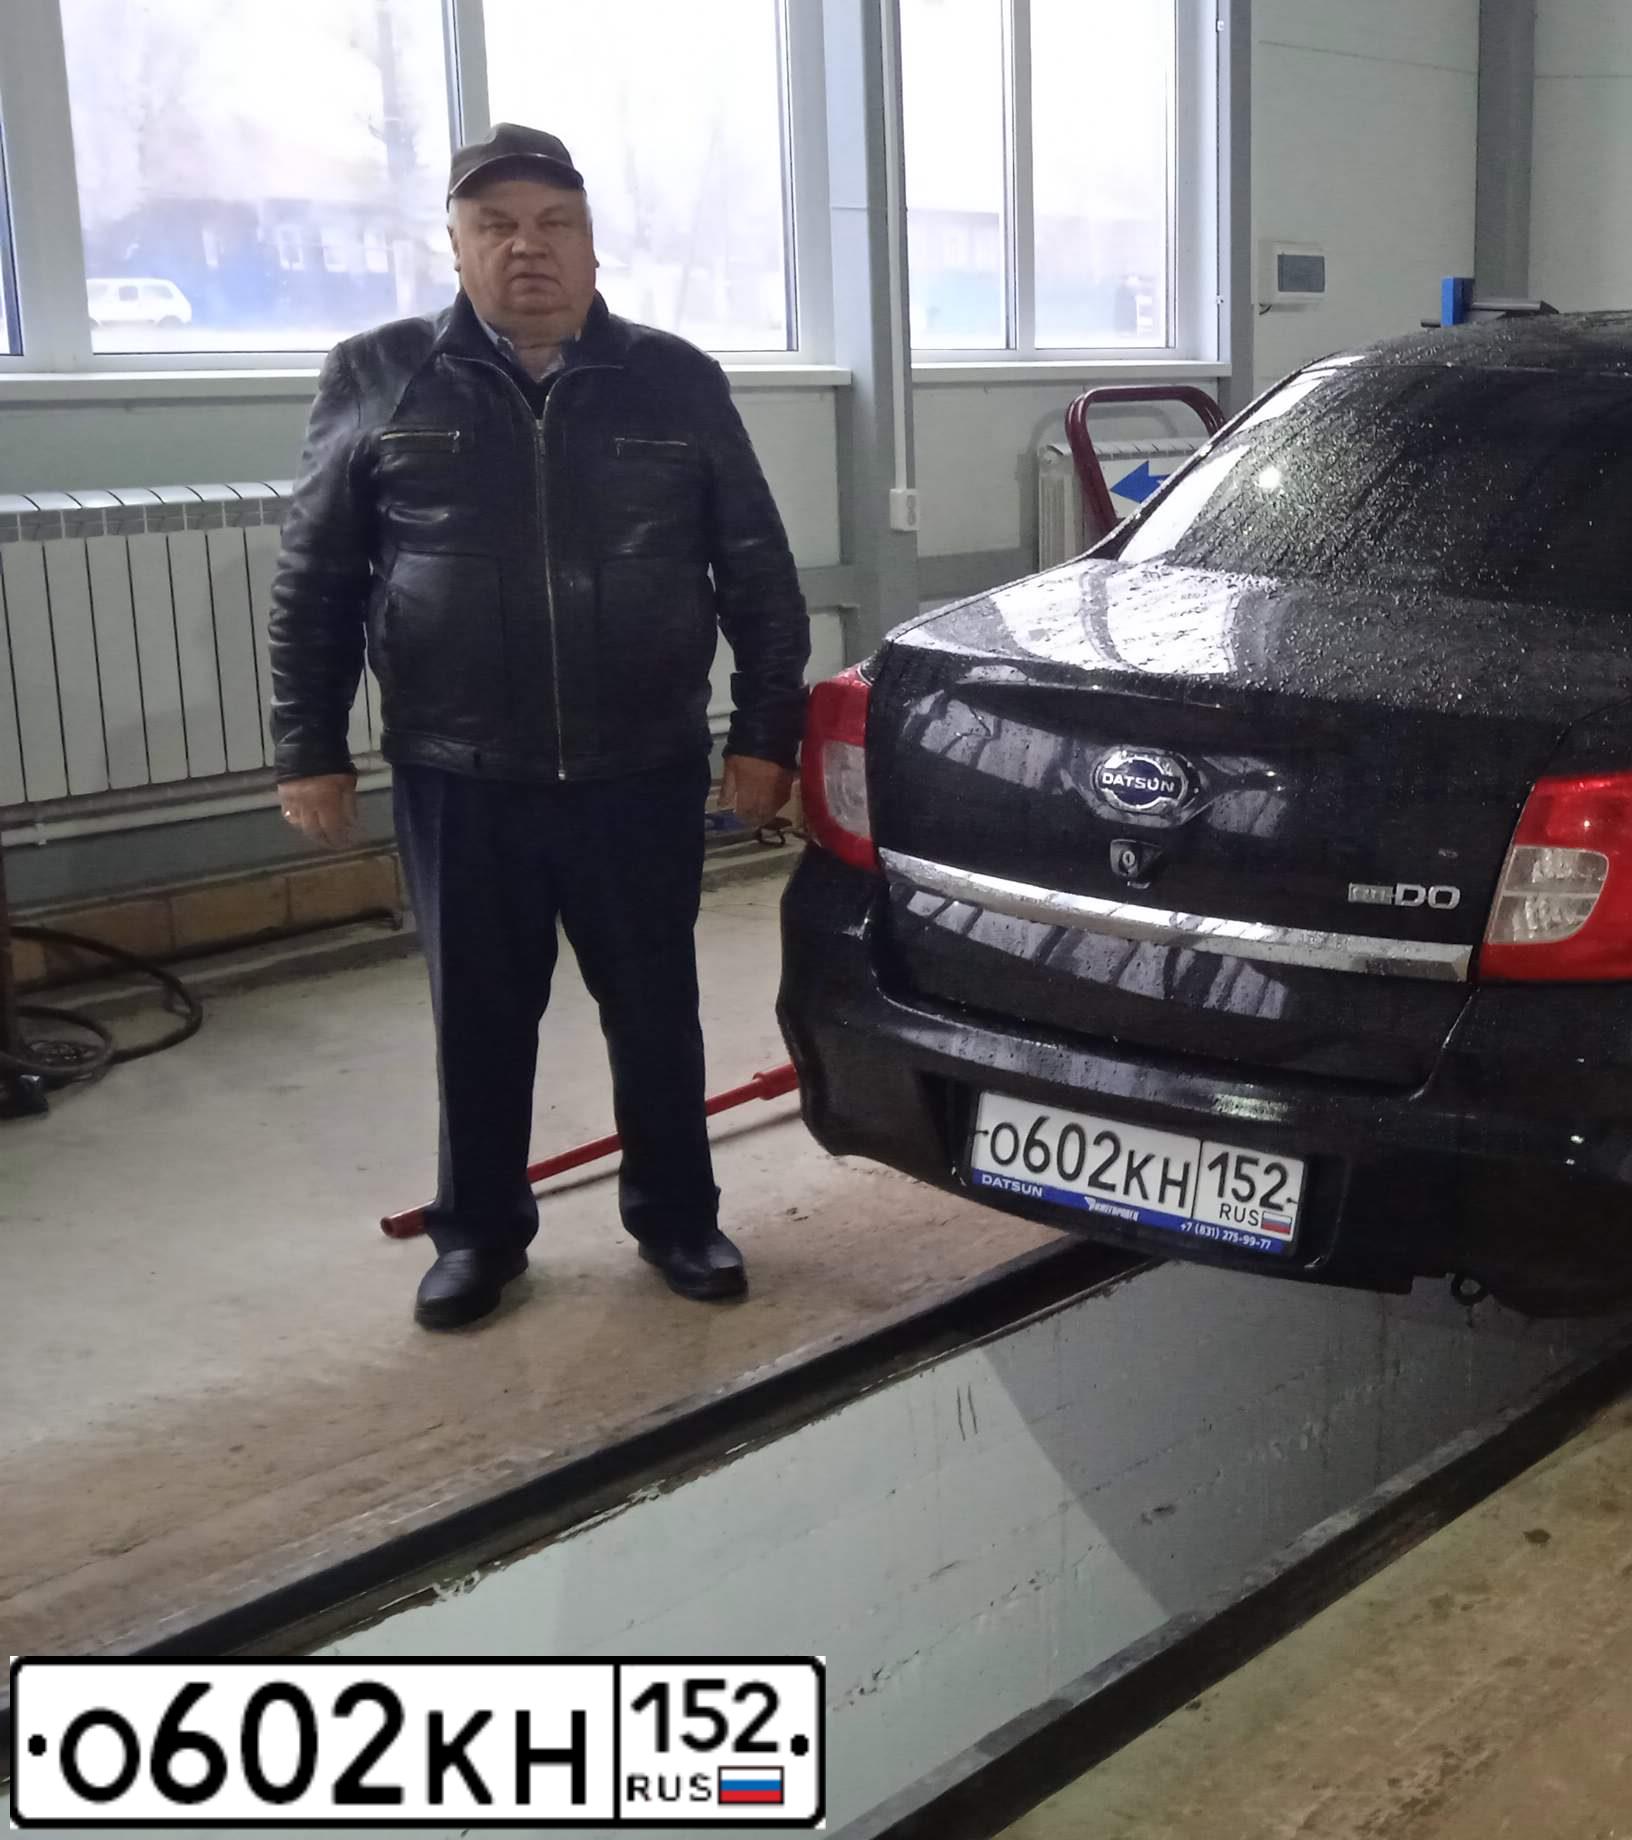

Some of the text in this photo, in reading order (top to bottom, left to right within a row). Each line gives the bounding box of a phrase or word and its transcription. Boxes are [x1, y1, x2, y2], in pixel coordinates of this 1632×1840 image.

[1102, 772, 1175, 793] DATSUN
[981, 1174, 1043, 1198] DATSUN
[1208, 1152, 1289, 1211] 152
[1220, 1203, 1259, 1226] RUS
[1222, 1230, 1273, 1250] 275-99-77
